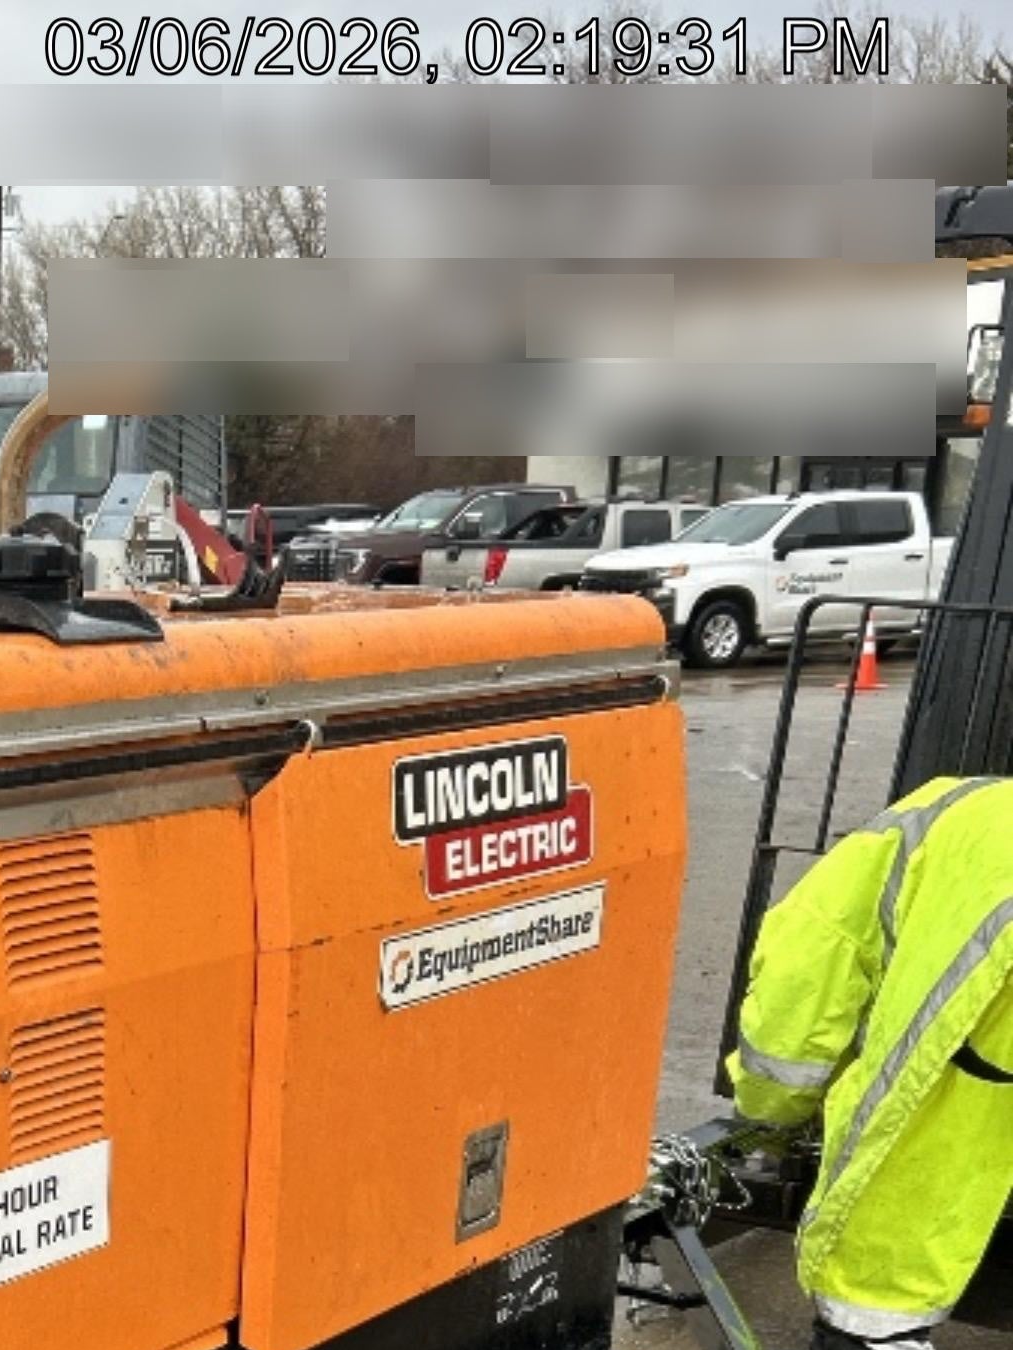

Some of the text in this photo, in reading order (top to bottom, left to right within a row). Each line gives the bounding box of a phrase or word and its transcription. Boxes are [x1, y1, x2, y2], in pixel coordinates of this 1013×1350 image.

[403, 749, 559, 829] LINCOLN
[445, 816, 577, 883] ELECTRIC
[416, 911, 594, 982] EquipmentShare
[37, 1205, 94, 1249] RATE
